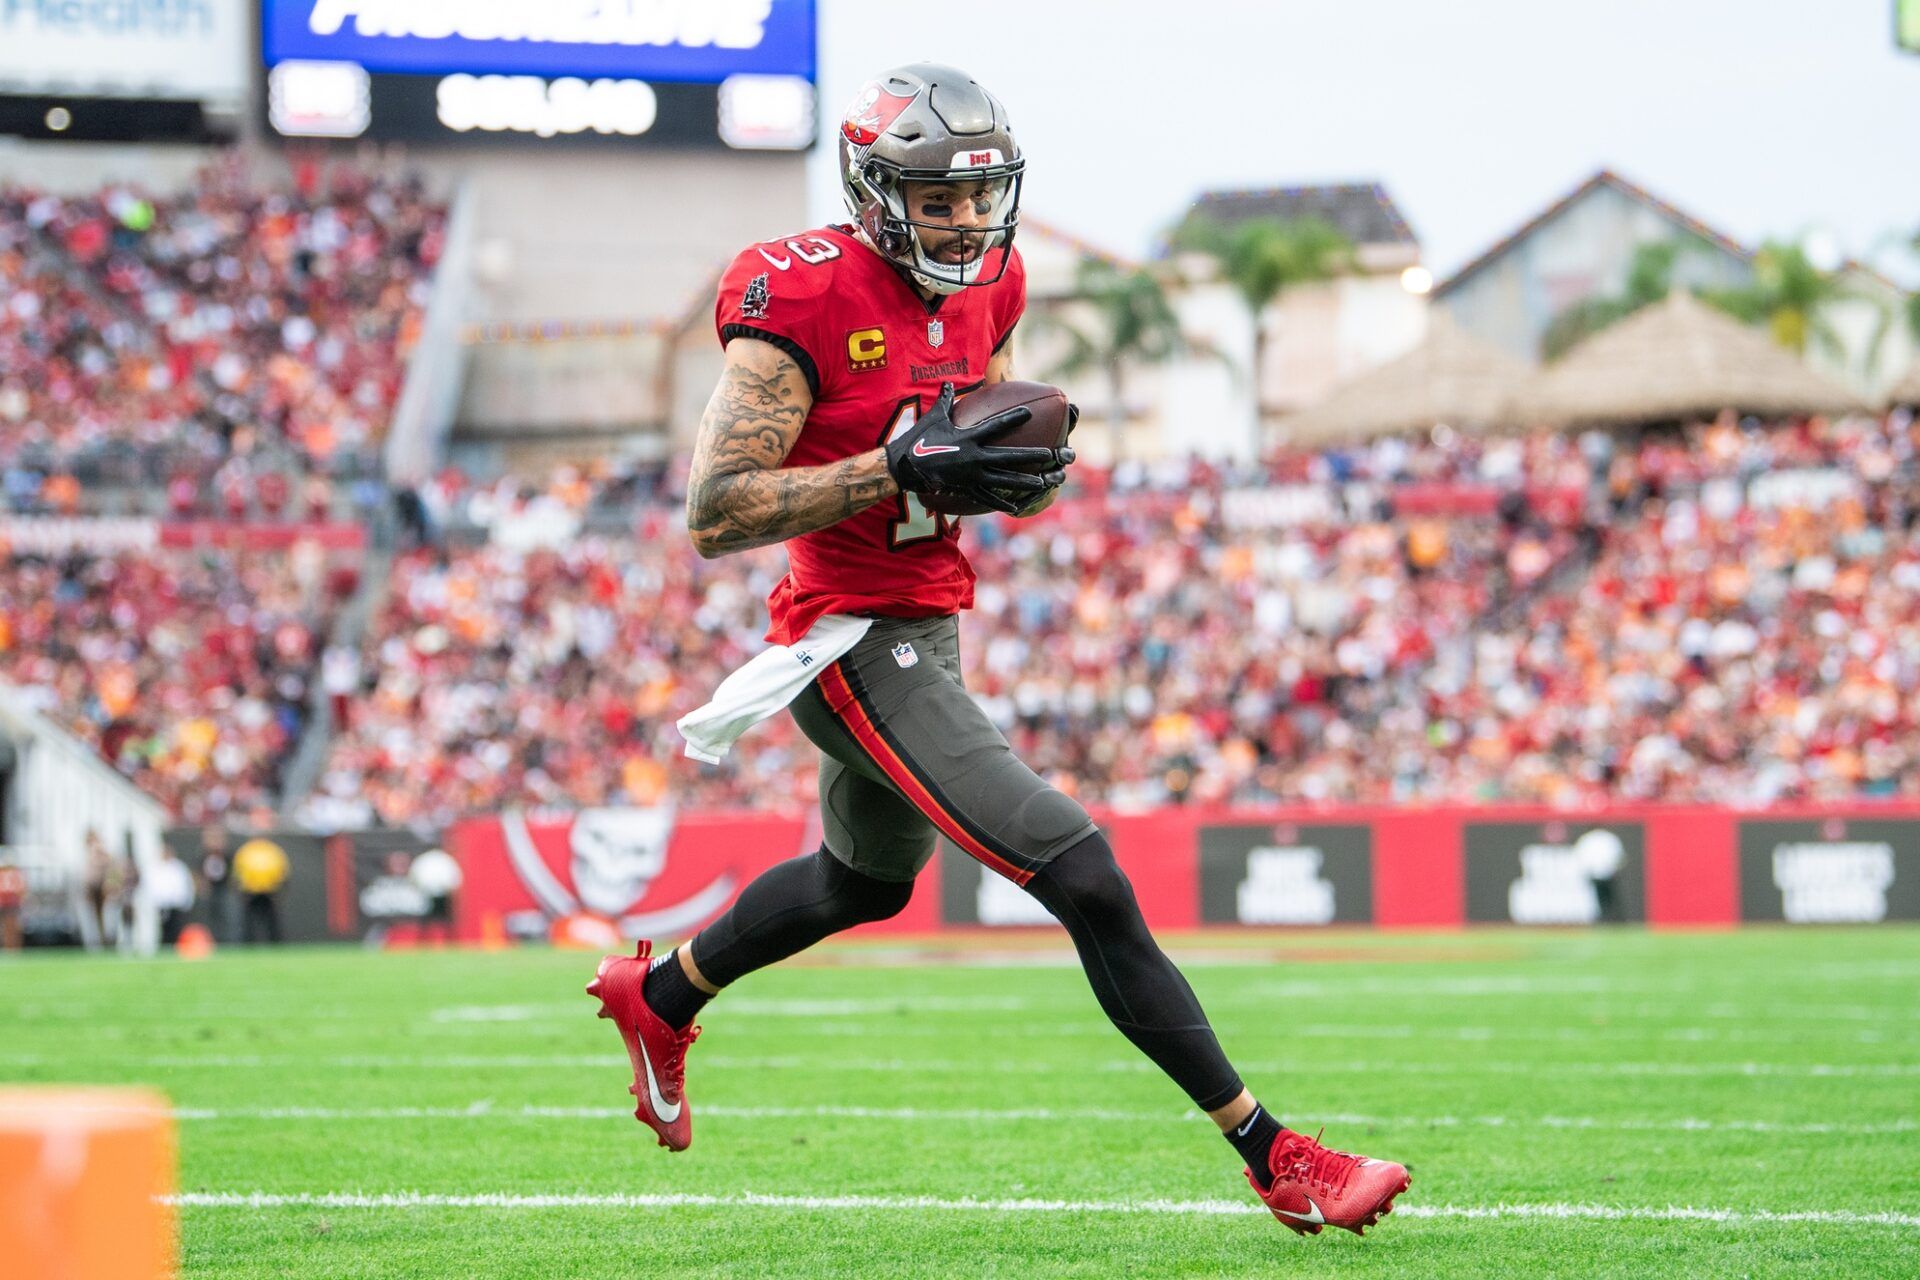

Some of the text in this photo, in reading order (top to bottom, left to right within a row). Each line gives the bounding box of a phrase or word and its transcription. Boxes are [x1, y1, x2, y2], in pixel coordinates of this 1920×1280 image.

[969, 152, 991, 166] BUCS
[848, 328, 885, 361] C
[910, 357, 969, 382] BUCCANEERS
